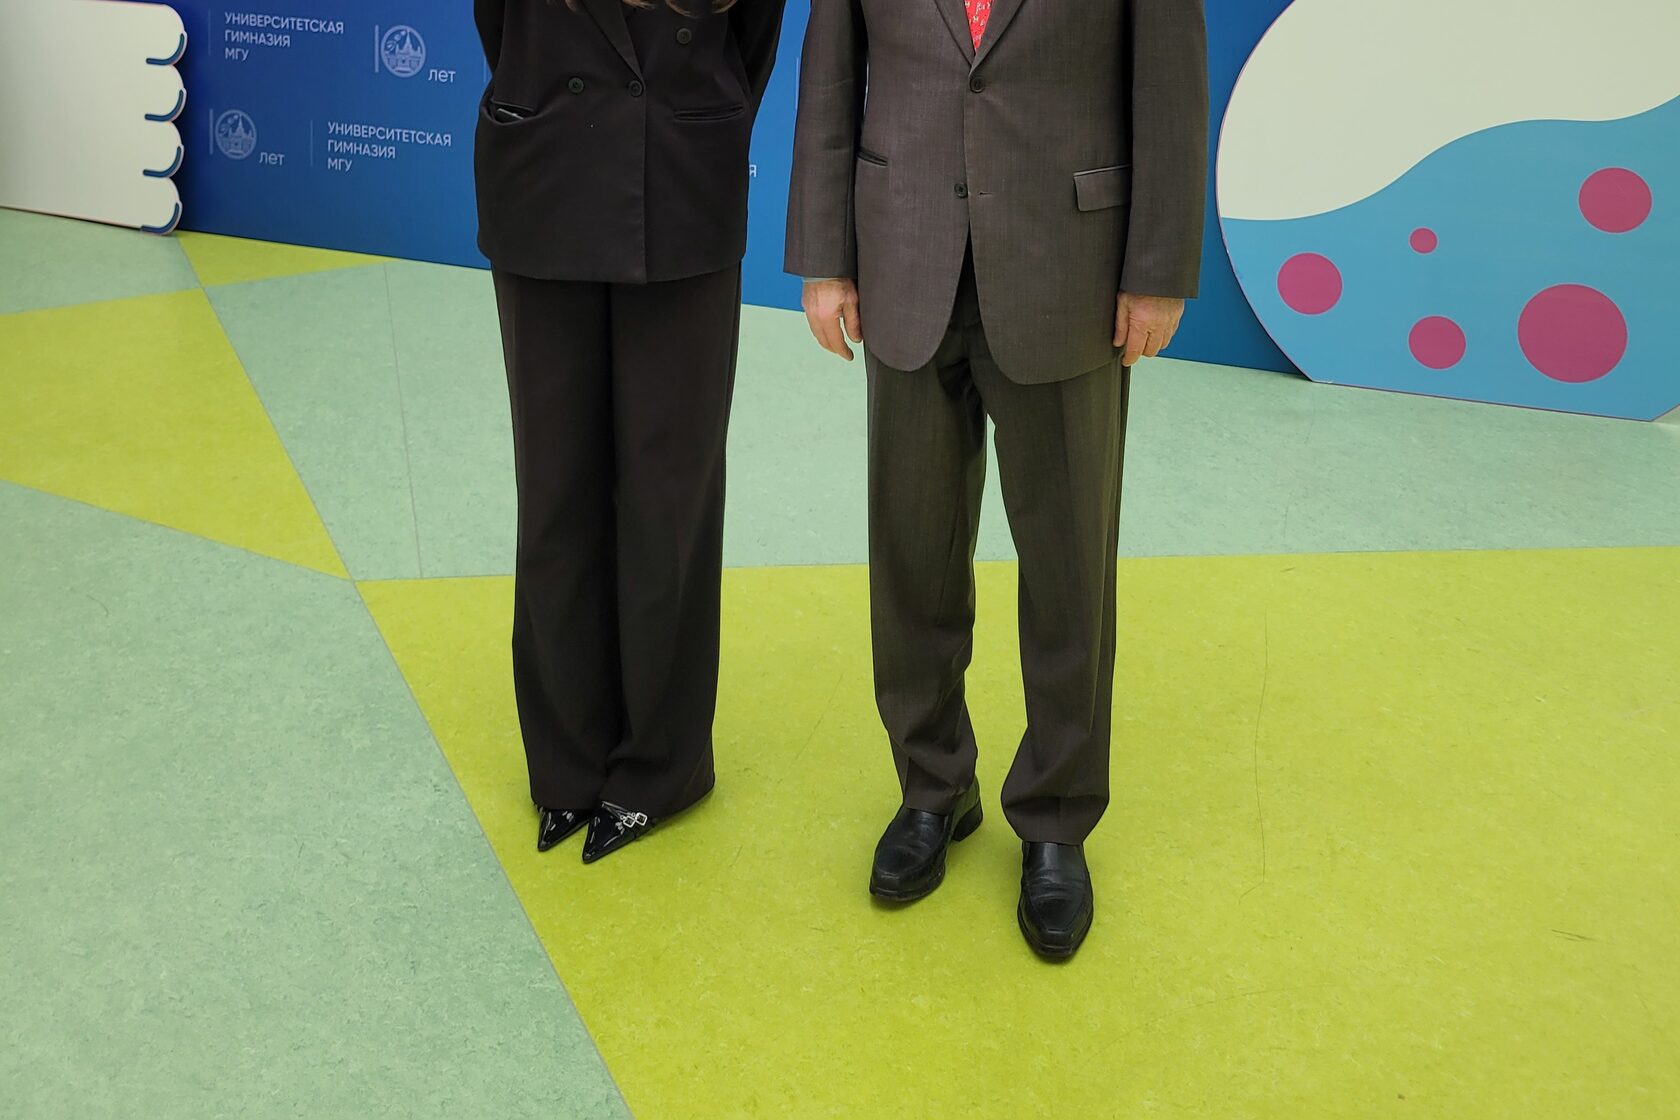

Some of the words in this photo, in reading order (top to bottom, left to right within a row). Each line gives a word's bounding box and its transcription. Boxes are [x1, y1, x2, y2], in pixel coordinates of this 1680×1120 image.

[225, 12, 344, 34] УНИВЕРСИТЕТСКАЯ
[225, 30, 291, 48] ГИМНАЗИЯ
[225, 48, 249, 61] МГУ
[428, 68, 456, 83] лет
[327, 121, 452, 147] УНИВЕРСИТЕТСКАЯ
[327, 139, 396, 159] ГИМНАЗИЯ
[259, 151, 285, 166] лет
[327, 157, 353, 172] МГУ
